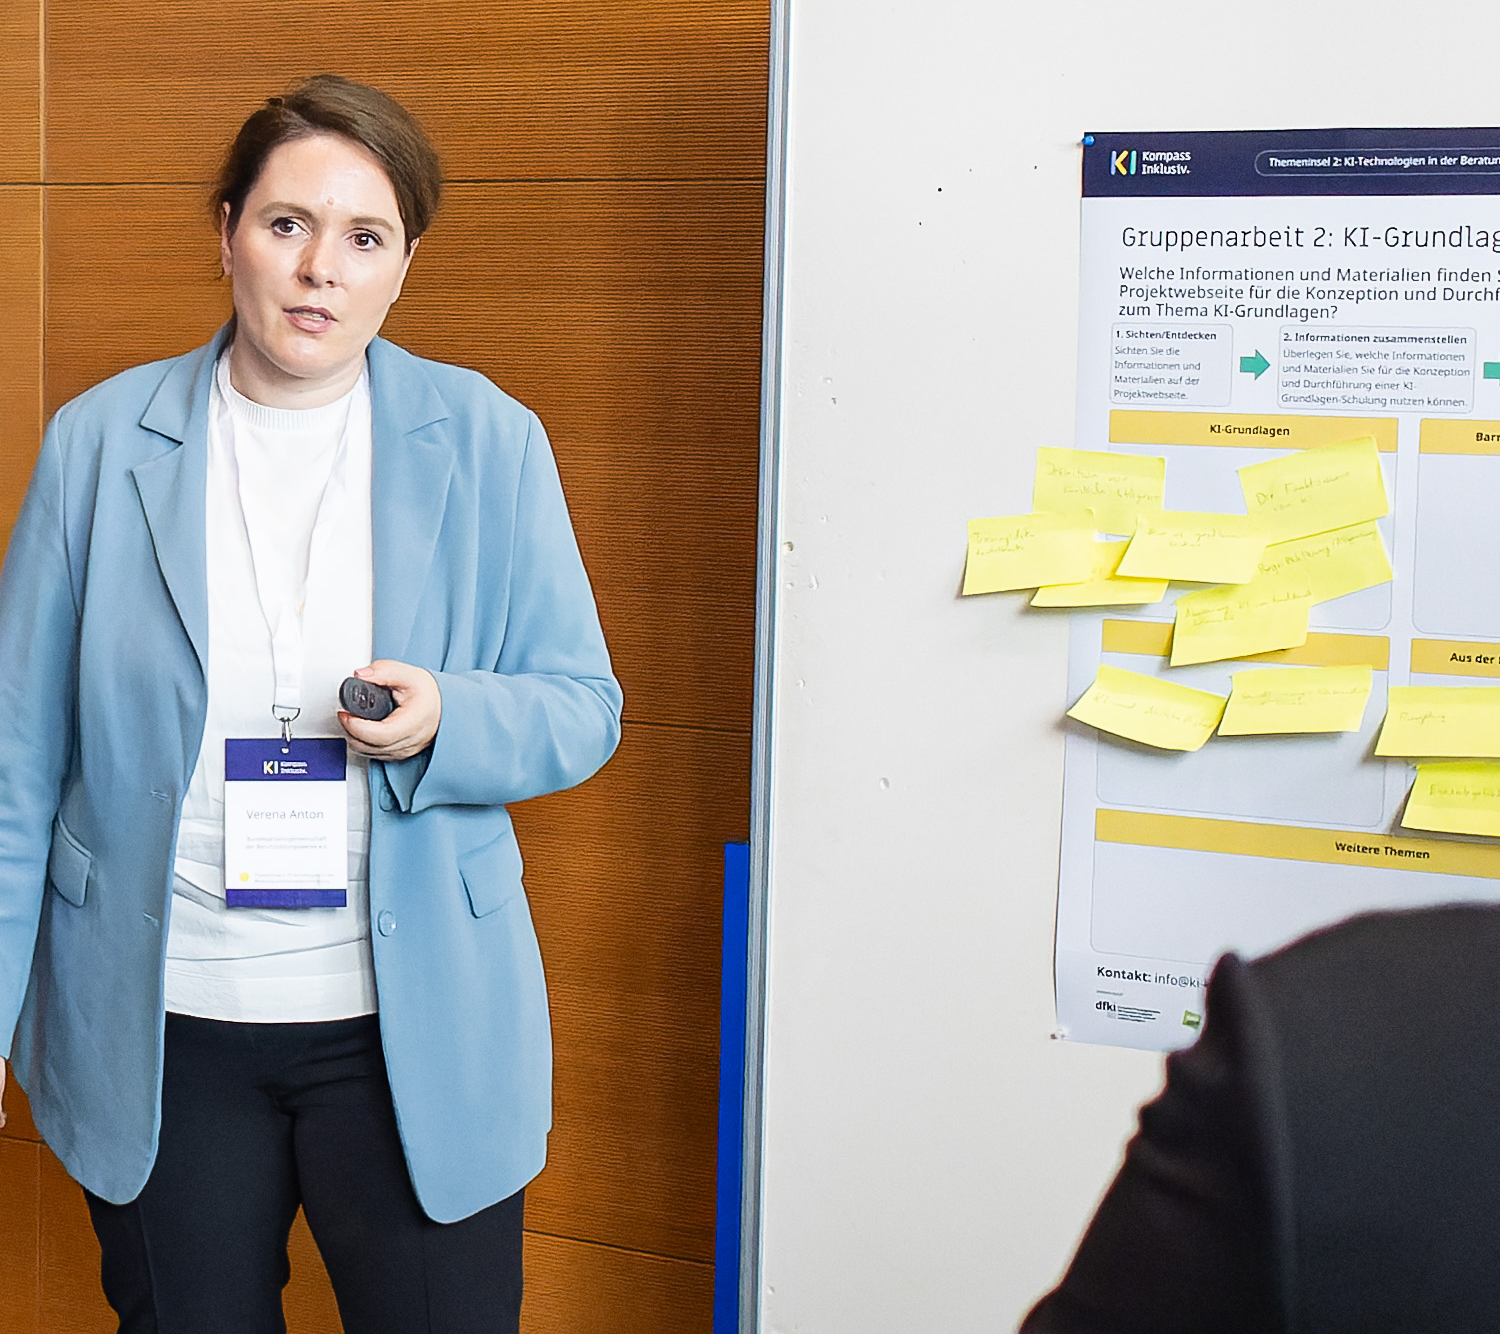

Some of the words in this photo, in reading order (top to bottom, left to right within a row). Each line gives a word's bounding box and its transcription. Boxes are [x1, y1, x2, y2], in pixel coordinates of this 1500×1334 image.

[1110, 150, 1137, 175] KI
[1142, 151, 1191, 163] Kompass
[1269, 157, 1331, 167] Themeninsel
[1344, 155, 1425, 169] KI-Technologien
[1428, 155, 1438, 165] in
[1440, 155, 1458, 165] der
[1122, 226, 1304, 251] Gruppenarbeit
[1313, 227, 1333, 247] 2:
[1120, 267, 1174, 281] Welche
[1180, 267, 1295, 282] Informationen
[1300, 267, 1330, 282] und
[1337, 267, 1431, 282] Materialien
[1437, 268, 1491, 282] finden
[1119, 285, 1244, 302] Projektwebseite
[1249, 285, 1271, 299] für
[1276, 285, 1300, 300] die
[1306, 286, 1399, 303] Konzeption
[1404, 287, 1436, 301] und
[1119, 305, 1150, 316] zum
[1156, 303, 1208, 317] Thema
[1214, 304, 1338, 322] KI-Grundlagen?
[1126, 330, 1216, 341] Sichten/Entdecken
[1295, 332, 1370, 343] Informationen
[1373, 334, 1467, 344] zusammenstellen
[1115, 346, 1147, 355] Sichten
[1150, 346, 1164, 355] Sie
[1167, 346, 1180, 355] die
[1283, 349, 1333, 361] Überlegen
[1355, 350, 1389, 360] welche
[1393, 351, 1465, 362] Informationen
[1114, 360, 1179, 370] Informationen
[1183, 360, 1200, 370] und
[1283, 365, 1301, 374] und
[1304, 364, 1358, 375] Materialien
[1361, 365, 1375, 375] Sie
[1378, 365, 1393, 375] für
[1396, 366, 1410, 376] die
[1414, 367, 1471, 378] Konzeption
[1114, 375, 1165, 384] Materialien
[1168, 375, 1183, 385] auf
[1185, 376, 1199, 385] der
[1282, 380, 1300, 388] und
[1303, 379, 1372, 391] Durchführung
[1375, 381, 1400, 390] einer
[1281, 393, 1387, 407] Grundlagen-Schulung
[1390, 397, 1425, 407] nutzen
[1210, 425, 1290, 437] KI-Grundlagen
[1450, 653, 1472, 662] Aus
[1475, 655, 1495, 664] der
[263, 760, 279, 775] KI
[246, 810, 286, 820] Verena
[289, 810, 324, 820] Anton
[1335, 841, 1380, 856] Weitere
[1383, 845, 1431, 860] Themen
[1097, 966, 1151, 983] Kontakt:
[1095, 1000, 1116, 1012] dfki
